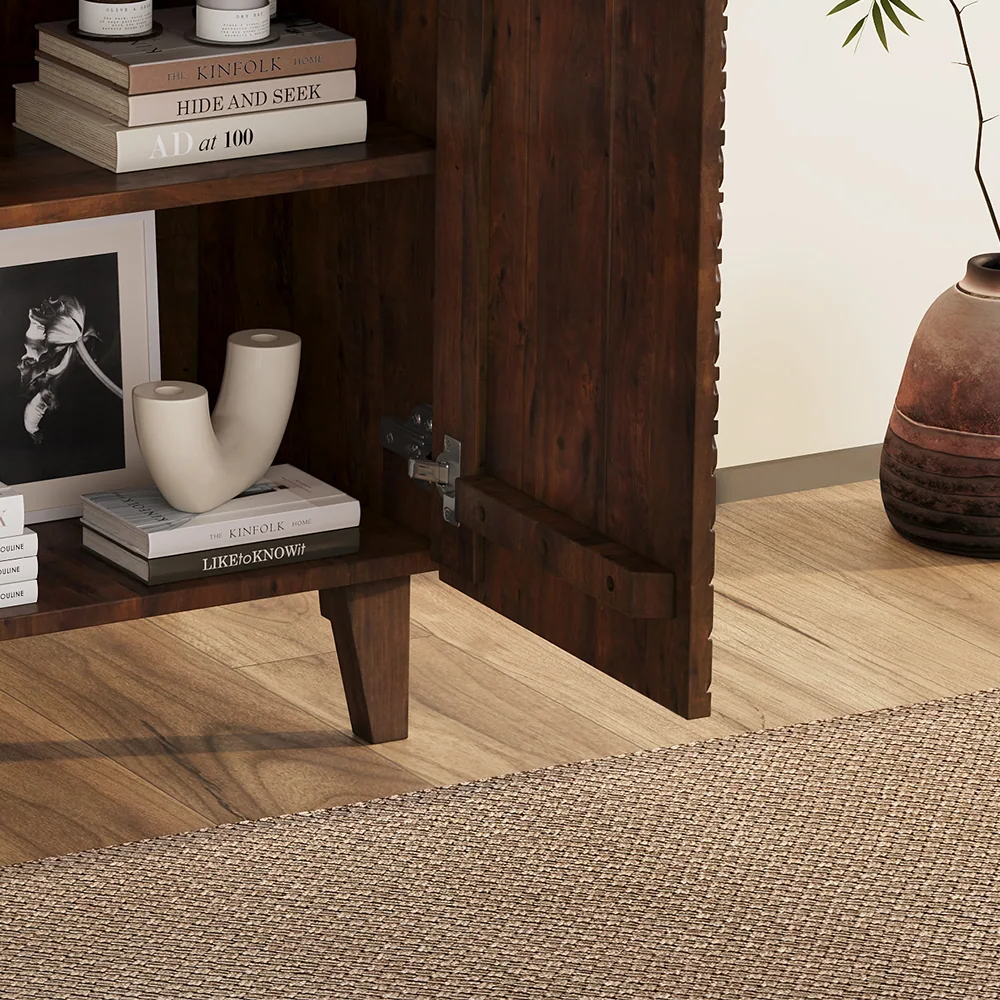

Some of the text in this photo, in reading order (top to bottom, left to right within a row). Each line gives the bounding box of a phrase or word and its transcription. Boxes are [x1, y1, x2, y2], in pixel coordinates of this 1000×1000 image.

[197, 57, 281, 80] KINFOLK
[293, 55, 323, 65] HOME
[177, 84, 322, 116] HIDE AND SEEK
[149, 128, 254, 159] AD at 100
[229, 521, 285, 539] KINFOLK
[291, 518, 311, 527] HOME
[202, 543, 306, 571] LIKEtoKNOWit
